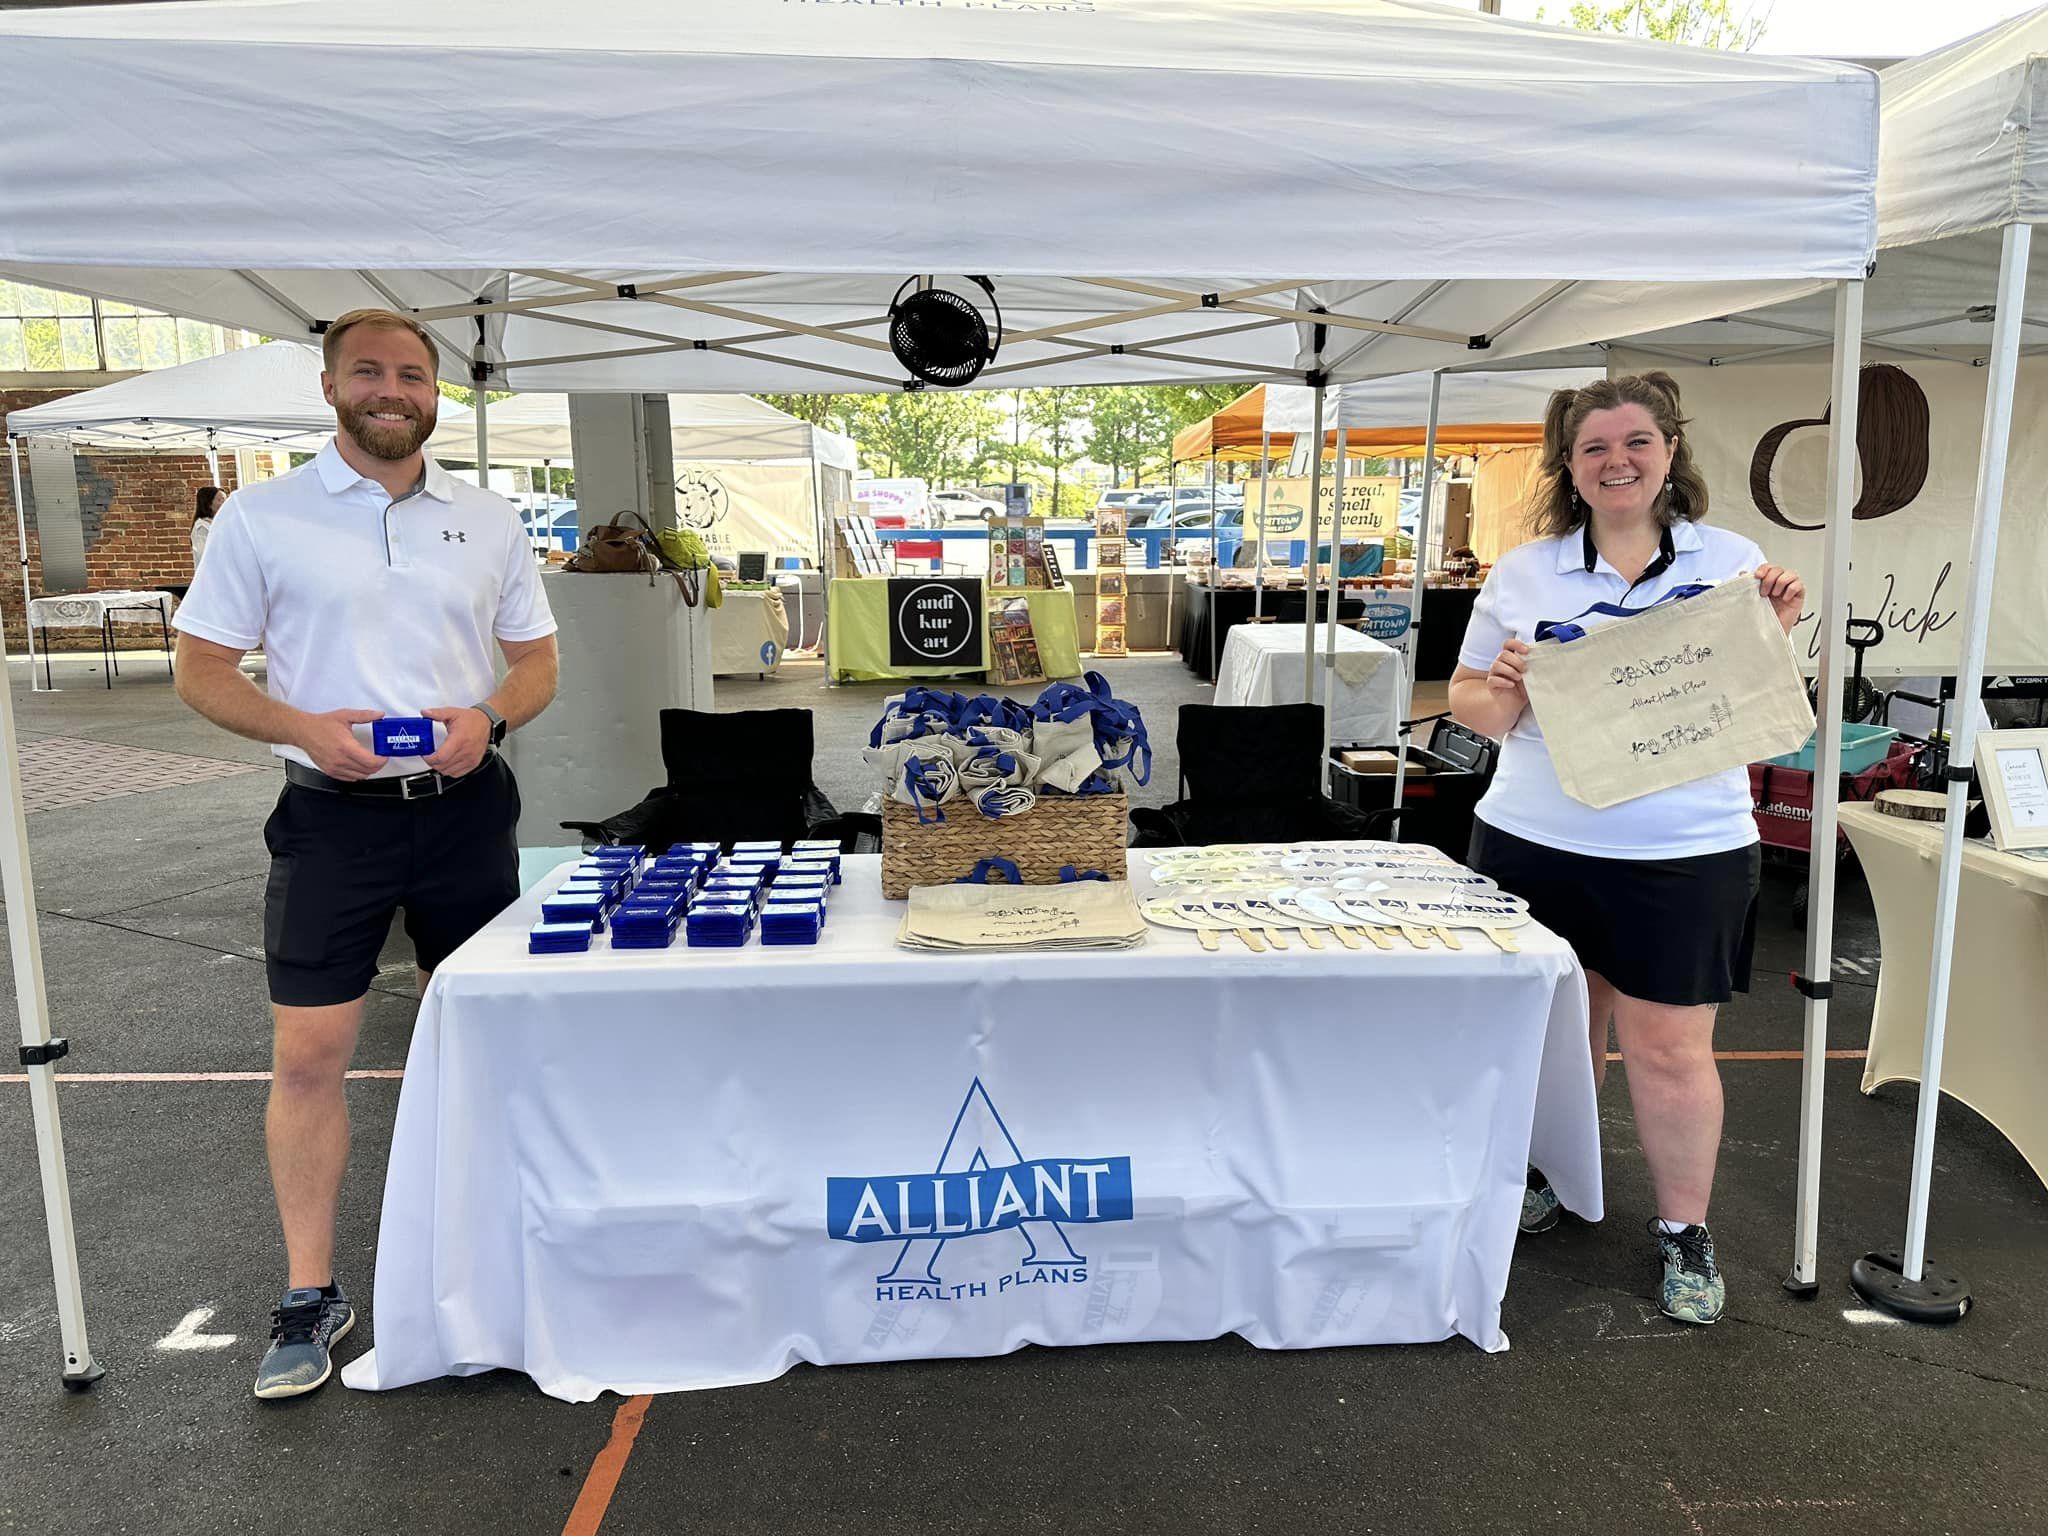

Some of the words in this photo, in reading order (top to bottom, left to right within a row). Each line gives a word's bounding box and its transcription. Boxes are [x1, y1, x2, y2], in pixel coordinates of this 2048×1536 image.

[966, 2, 1097, 13] PLANS
[916, 594, 954, 610] andi
[919, 614, 953, 629] kur
[923, 636, 949, 648] art
[844, 1163, 1111, 1237] ALLIANT
[876, 1281, 987, 1301] HEALTH
[998, 1267, 1088, 1293] PLANS
